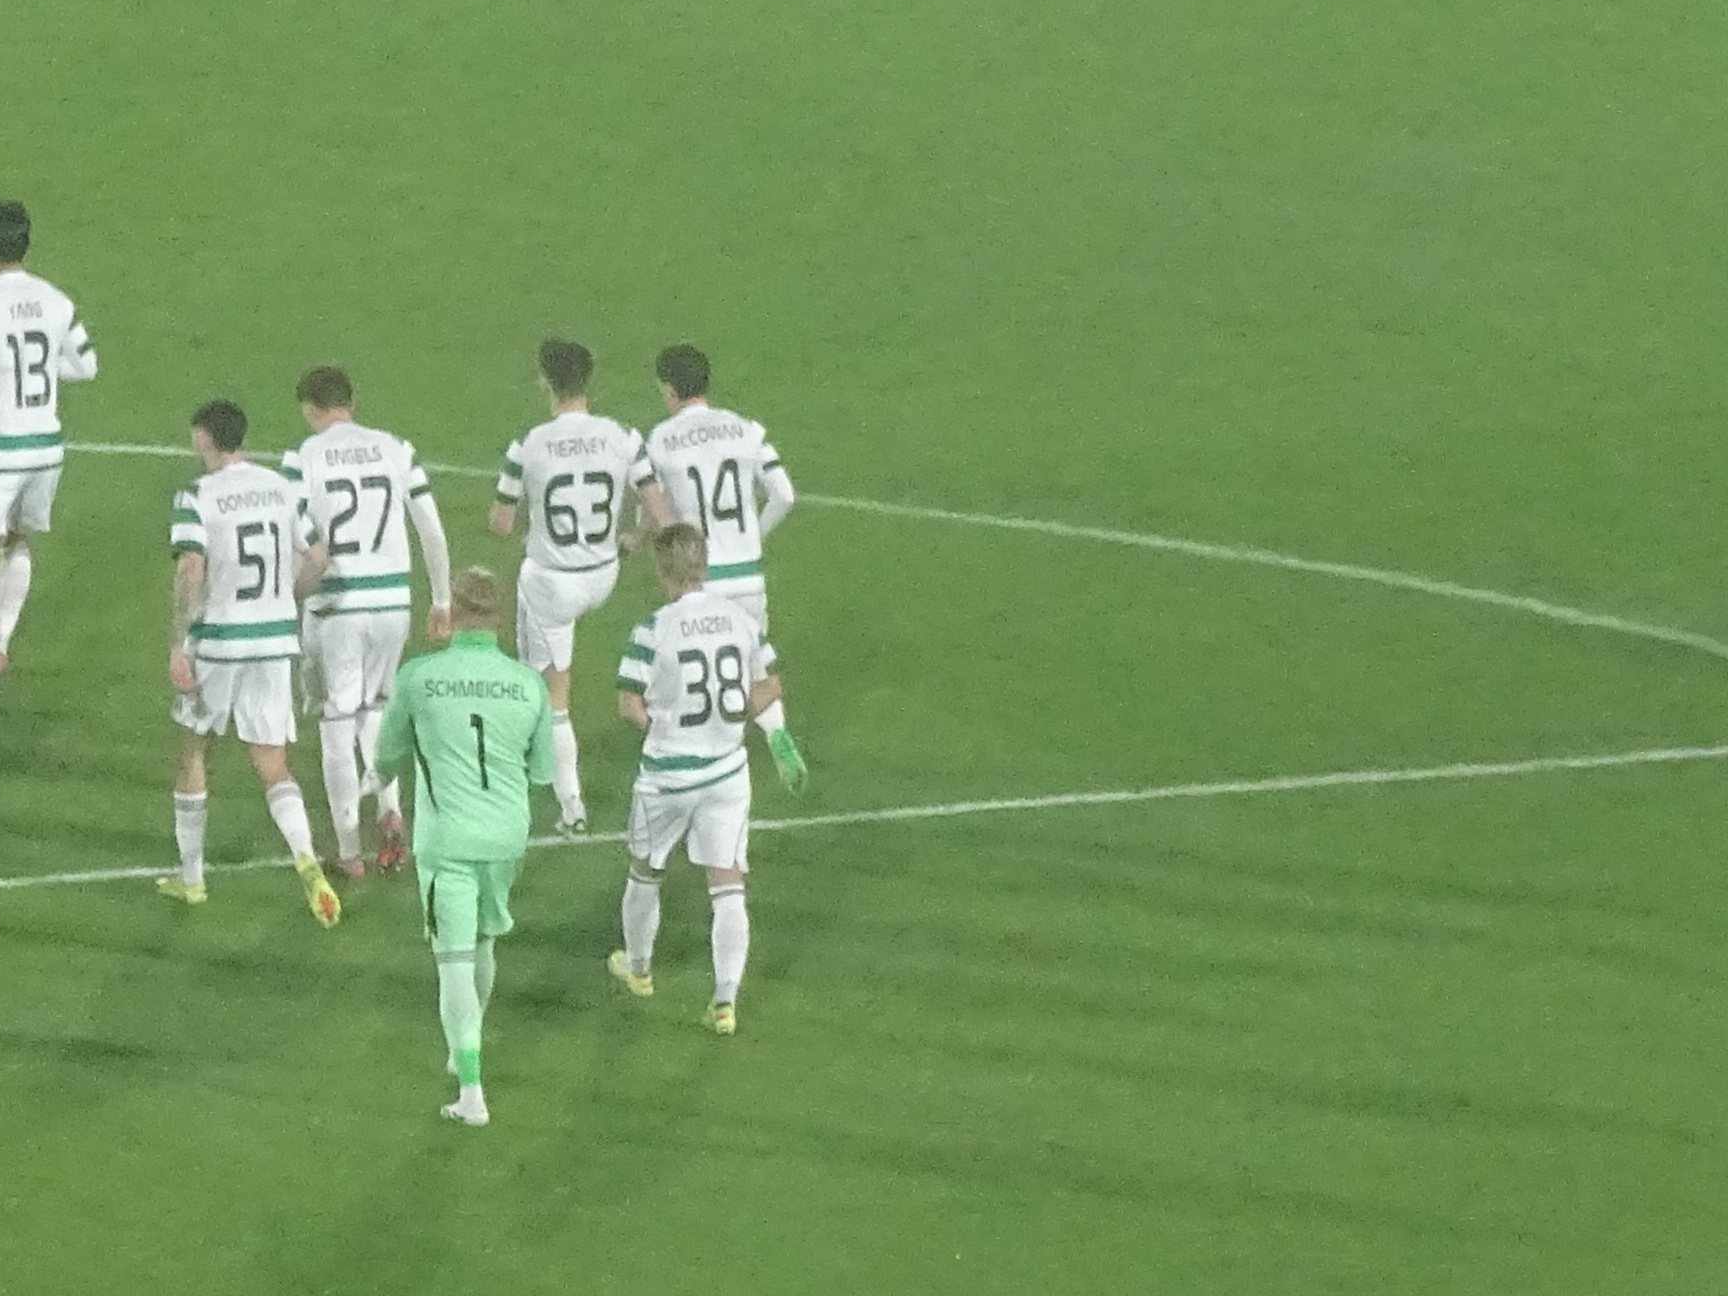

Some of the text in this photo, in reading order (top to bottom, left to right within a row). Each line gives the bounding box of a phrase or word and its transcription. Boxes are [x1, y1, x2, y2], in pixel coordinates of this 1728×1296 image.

[6, 331, 50, 409] 13
[325, 445, 382, 467] ENGELS
[546, 437, 607, 457] TIERNEY
[325, 475, 392, 555] 27
[546, 470, 614, 546] 63
[687, 458, 746, 536] 14
[236, 522, 281, 600] 51
[680, 616, 732, 637] DAIZEN
[425, 679, 530, 702] SCHMEICHEL
[677, 645, 747, 728] 38
[469, 713, 489, 790] 1
